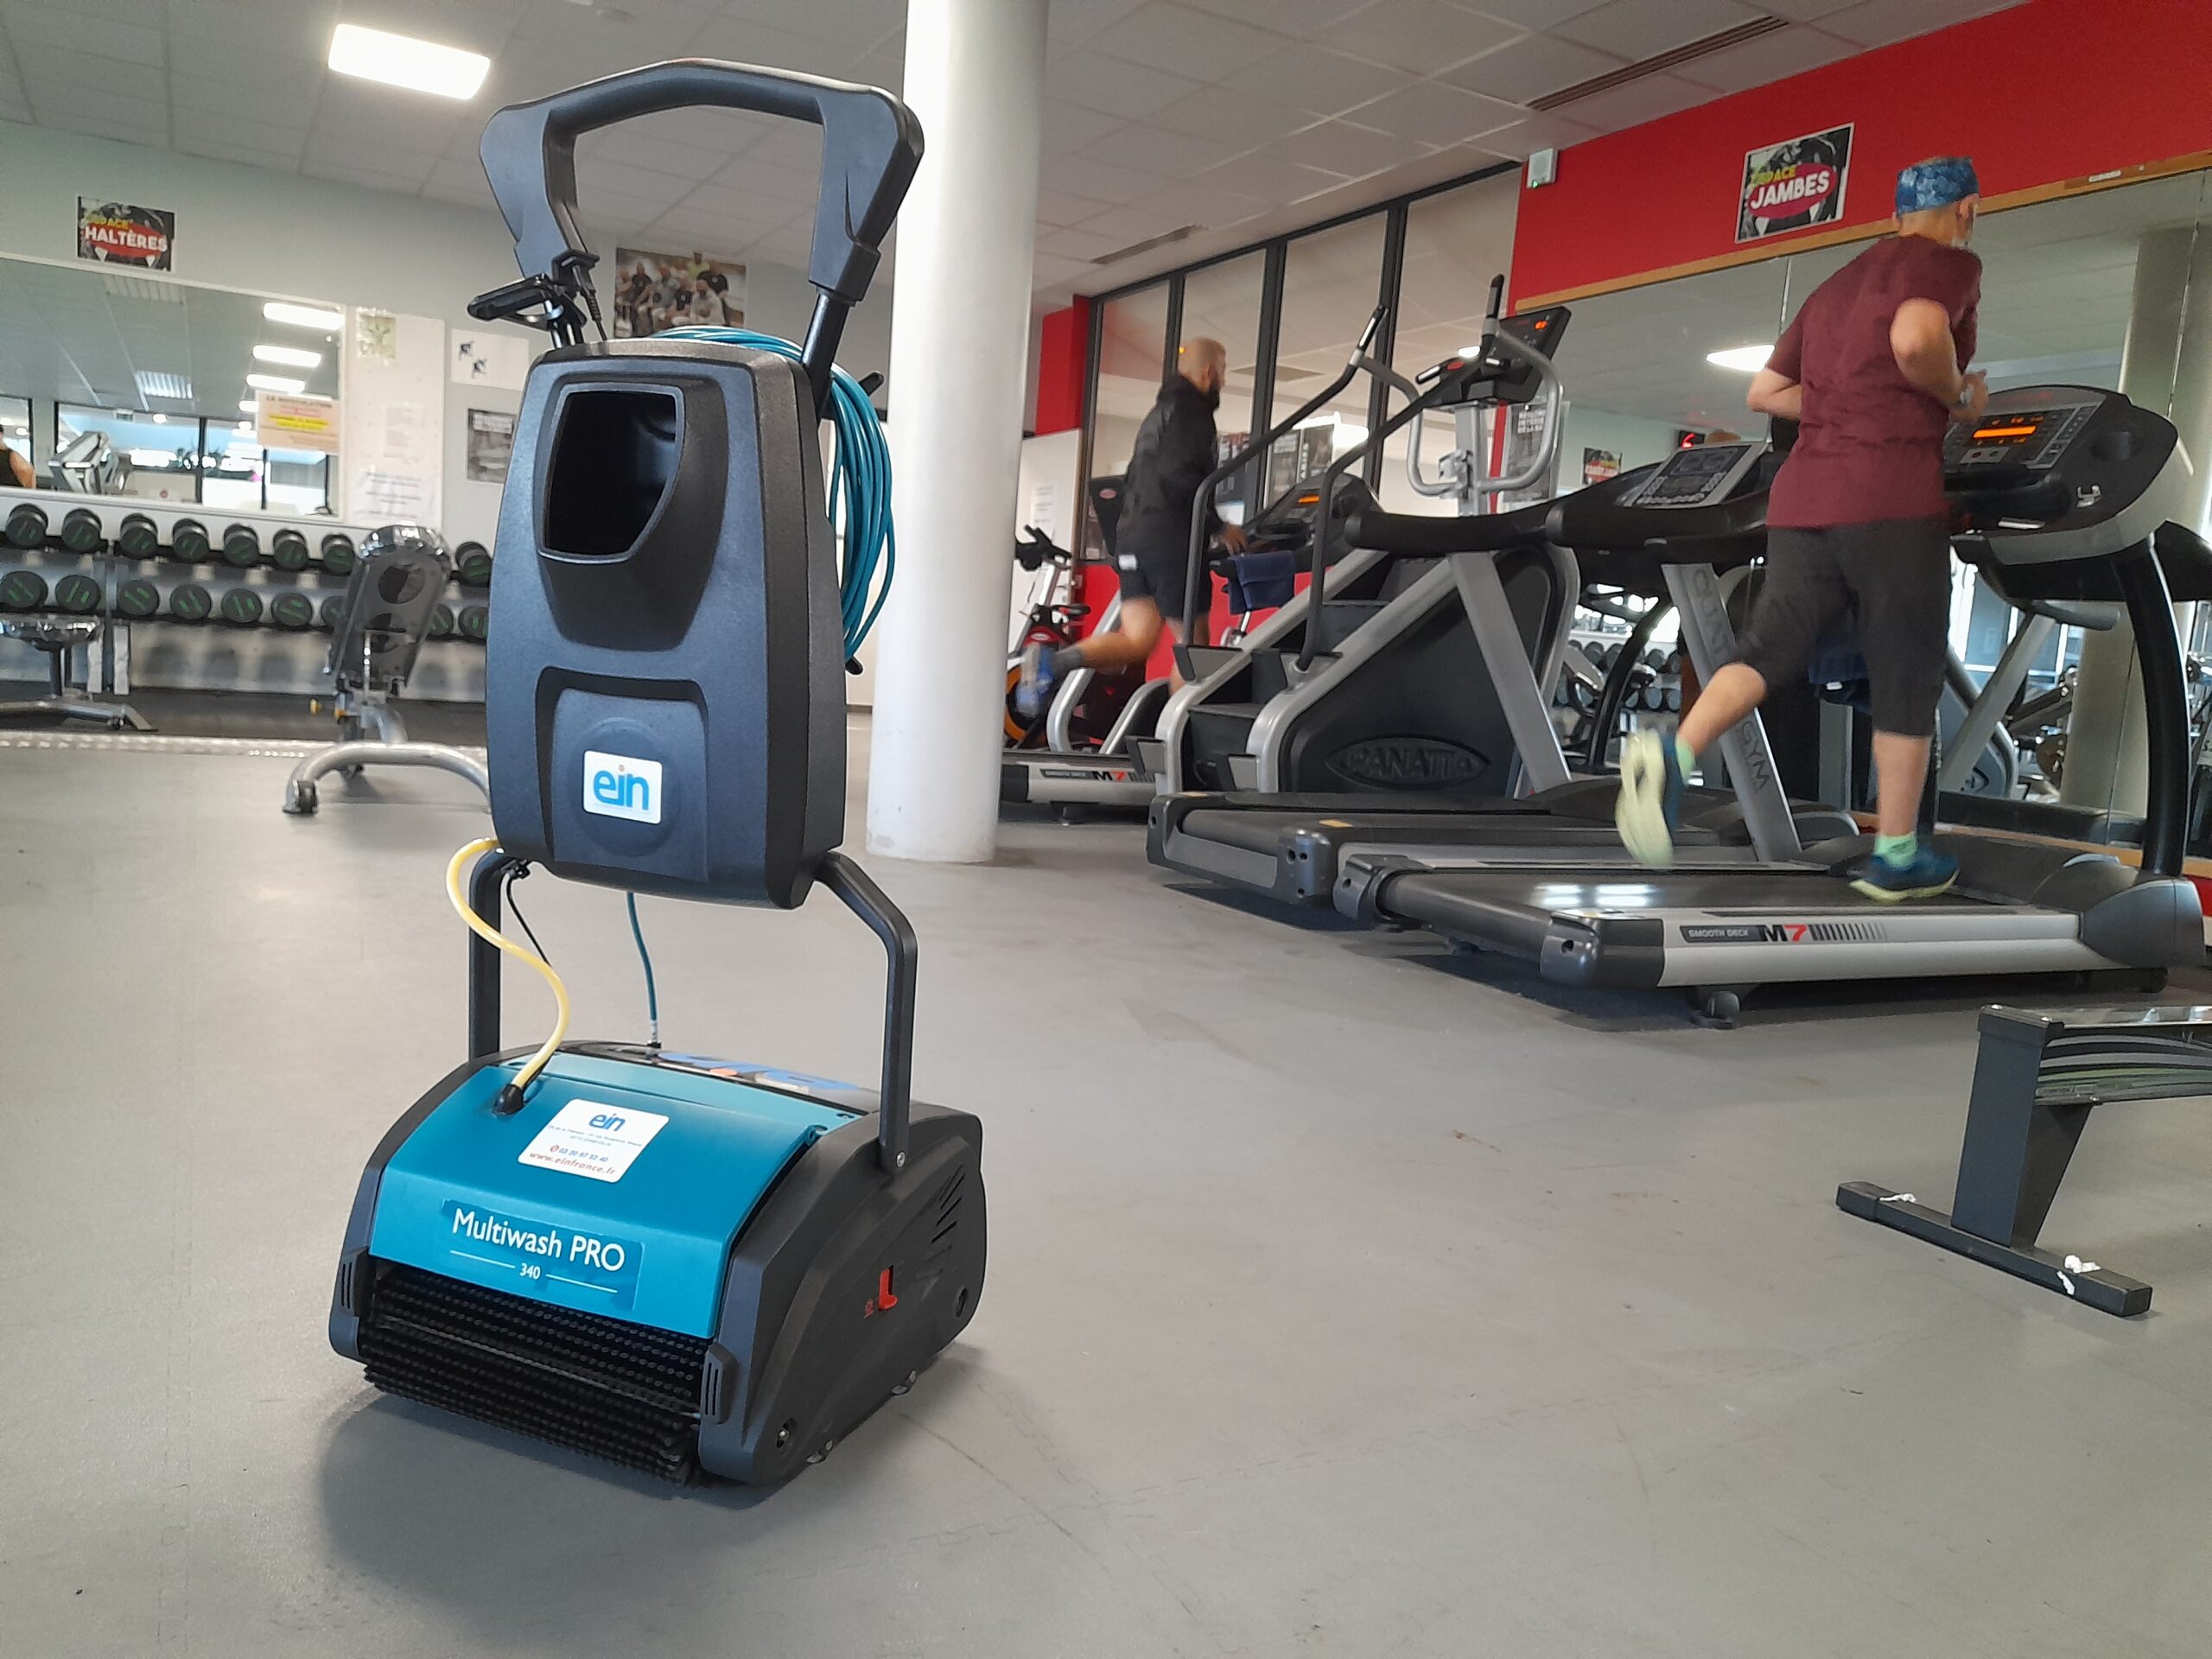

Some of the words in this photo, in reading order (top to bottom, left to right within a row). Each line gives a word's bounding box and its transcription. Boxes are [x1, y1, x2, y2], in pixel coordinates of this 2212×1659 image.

[1750, 170, 1831, 209] JAMBES
[85, 225, 168, 252] HALTÈRES
[1346, 747, 1483, 779] PANATTA
[1741, 720, 1770, 792] GYM
[593, 764, 649, 811] ein
[1091, 770, 1127, 782] M7
[1688, 929, 1726, 938] SMOOTH
[1726, 928, 1749, 938] DECK
[1760, 924, 1808, 942] M7
[588, 1112, 626, 1133] ein
[529, 1151, 616, 1176] www.einfrance.fr
[452, 1208, 563, 1259] Multiwash
[569, 1235, 626, 1272] PRO
[519, 1262, 541, 1280] 340
